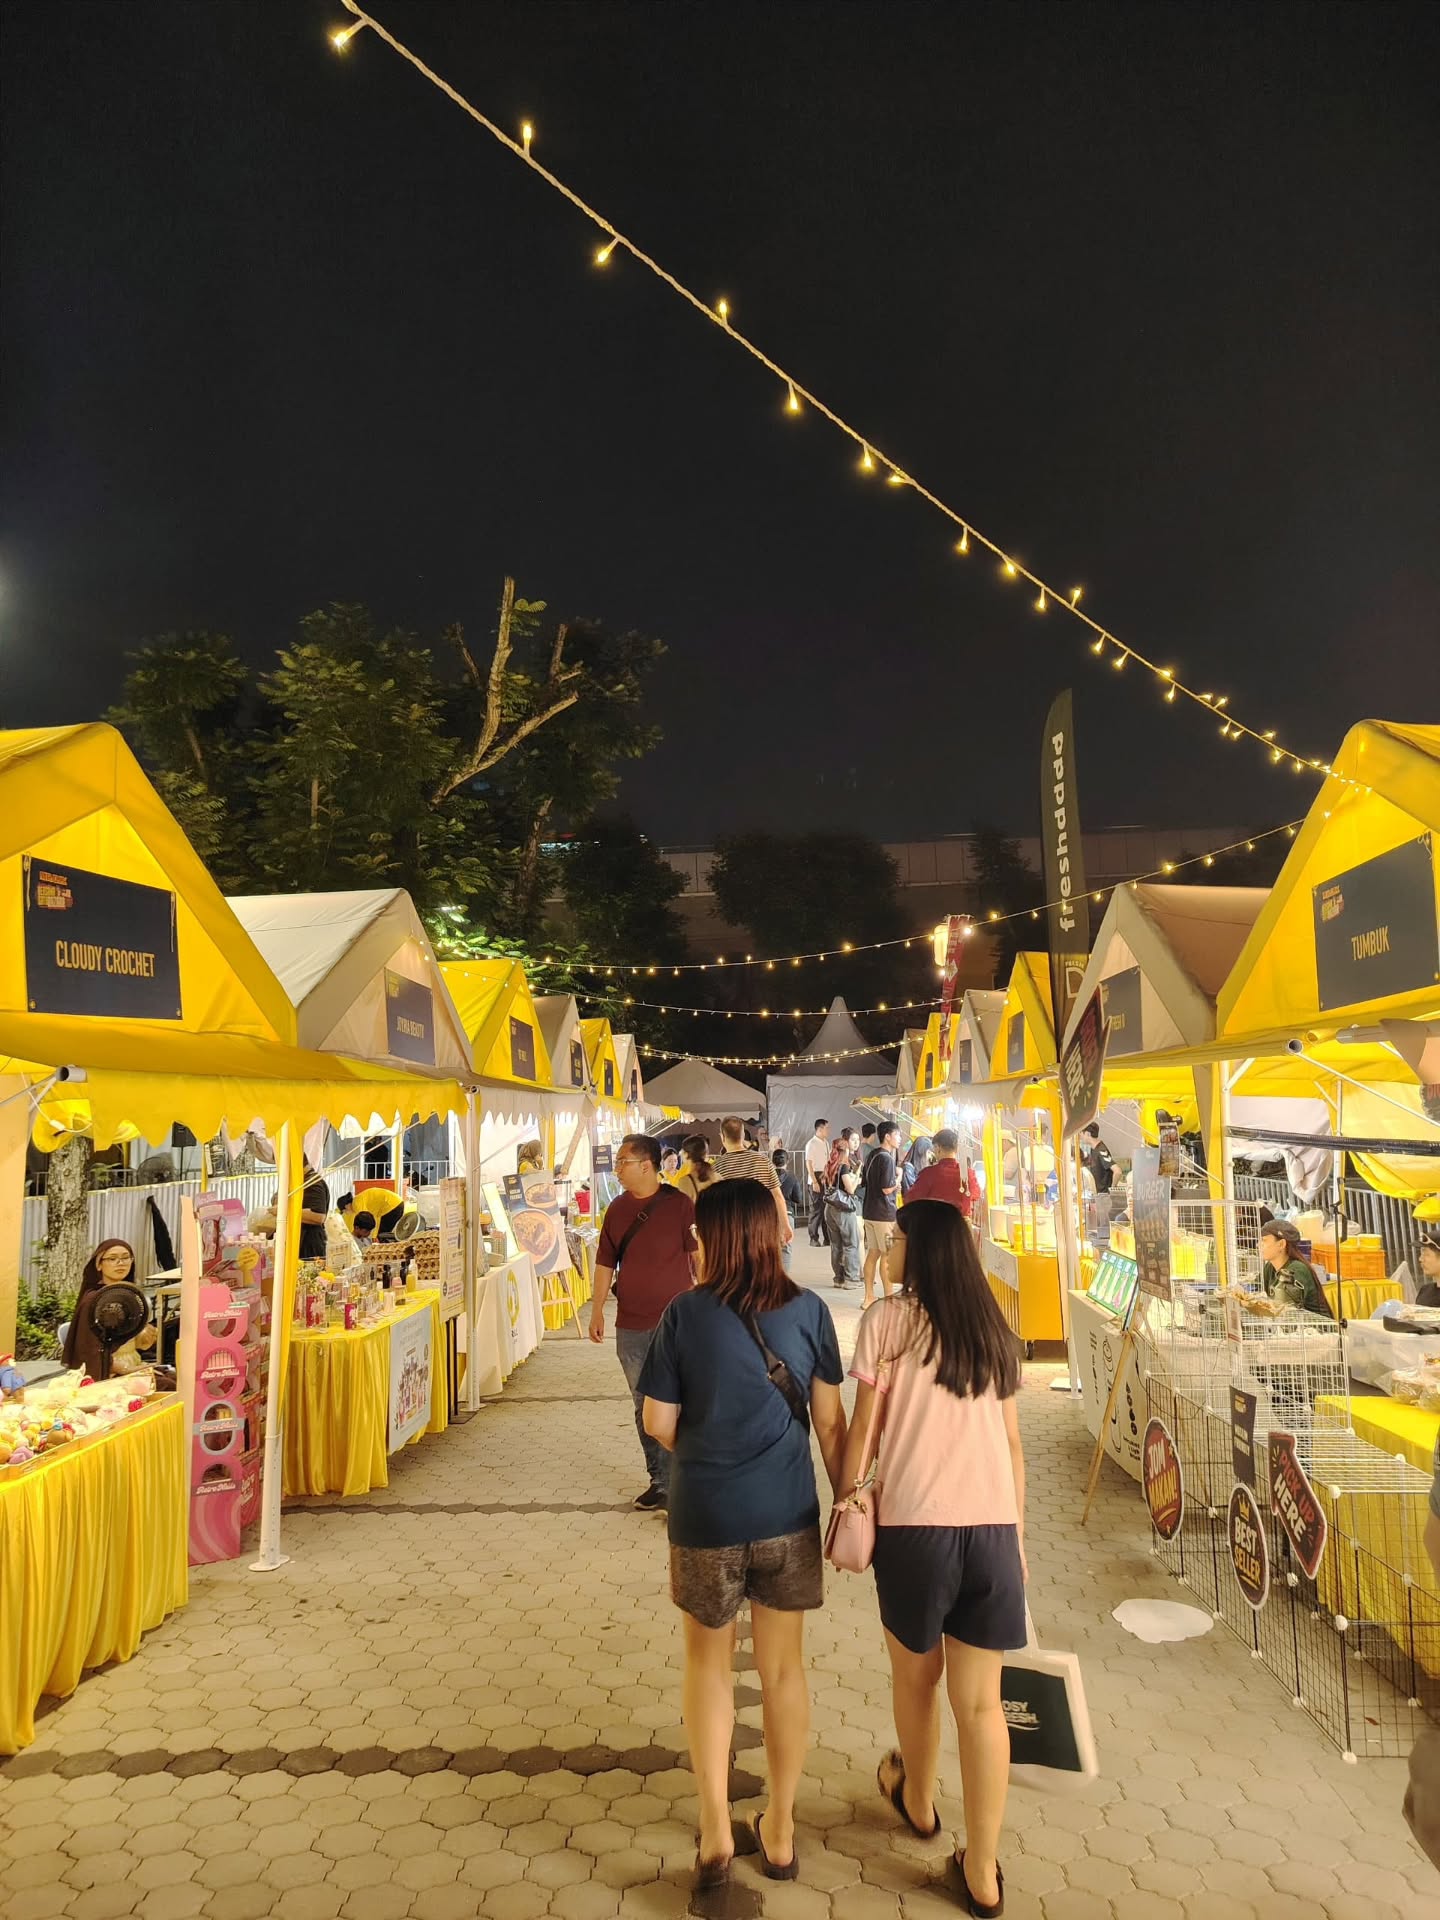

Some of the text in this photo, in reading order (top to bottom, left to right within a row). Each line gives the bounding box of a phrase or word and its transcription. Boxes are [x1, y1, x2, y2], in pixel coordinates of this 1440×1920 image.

[55, 940, 155, 977] CLOUDY CROCHET
[1351, 925, 1390, 960] TUMBUK
[1065, 1041, 1085, 1108] HERE
[1147, 1438, 1166, 1479] JOM
[1149, 1466, 1178, 1515] MAKAN!
[1280, 1449, 1315, 1523] PICK UP
[1273, 1472, 1307, 1543] HERE
[1234, 1516, 1258, 1557] BEST
[1234, 1544, 1261, 1586] SELLER
[1002, 1700, 1028, 1712] OSY
